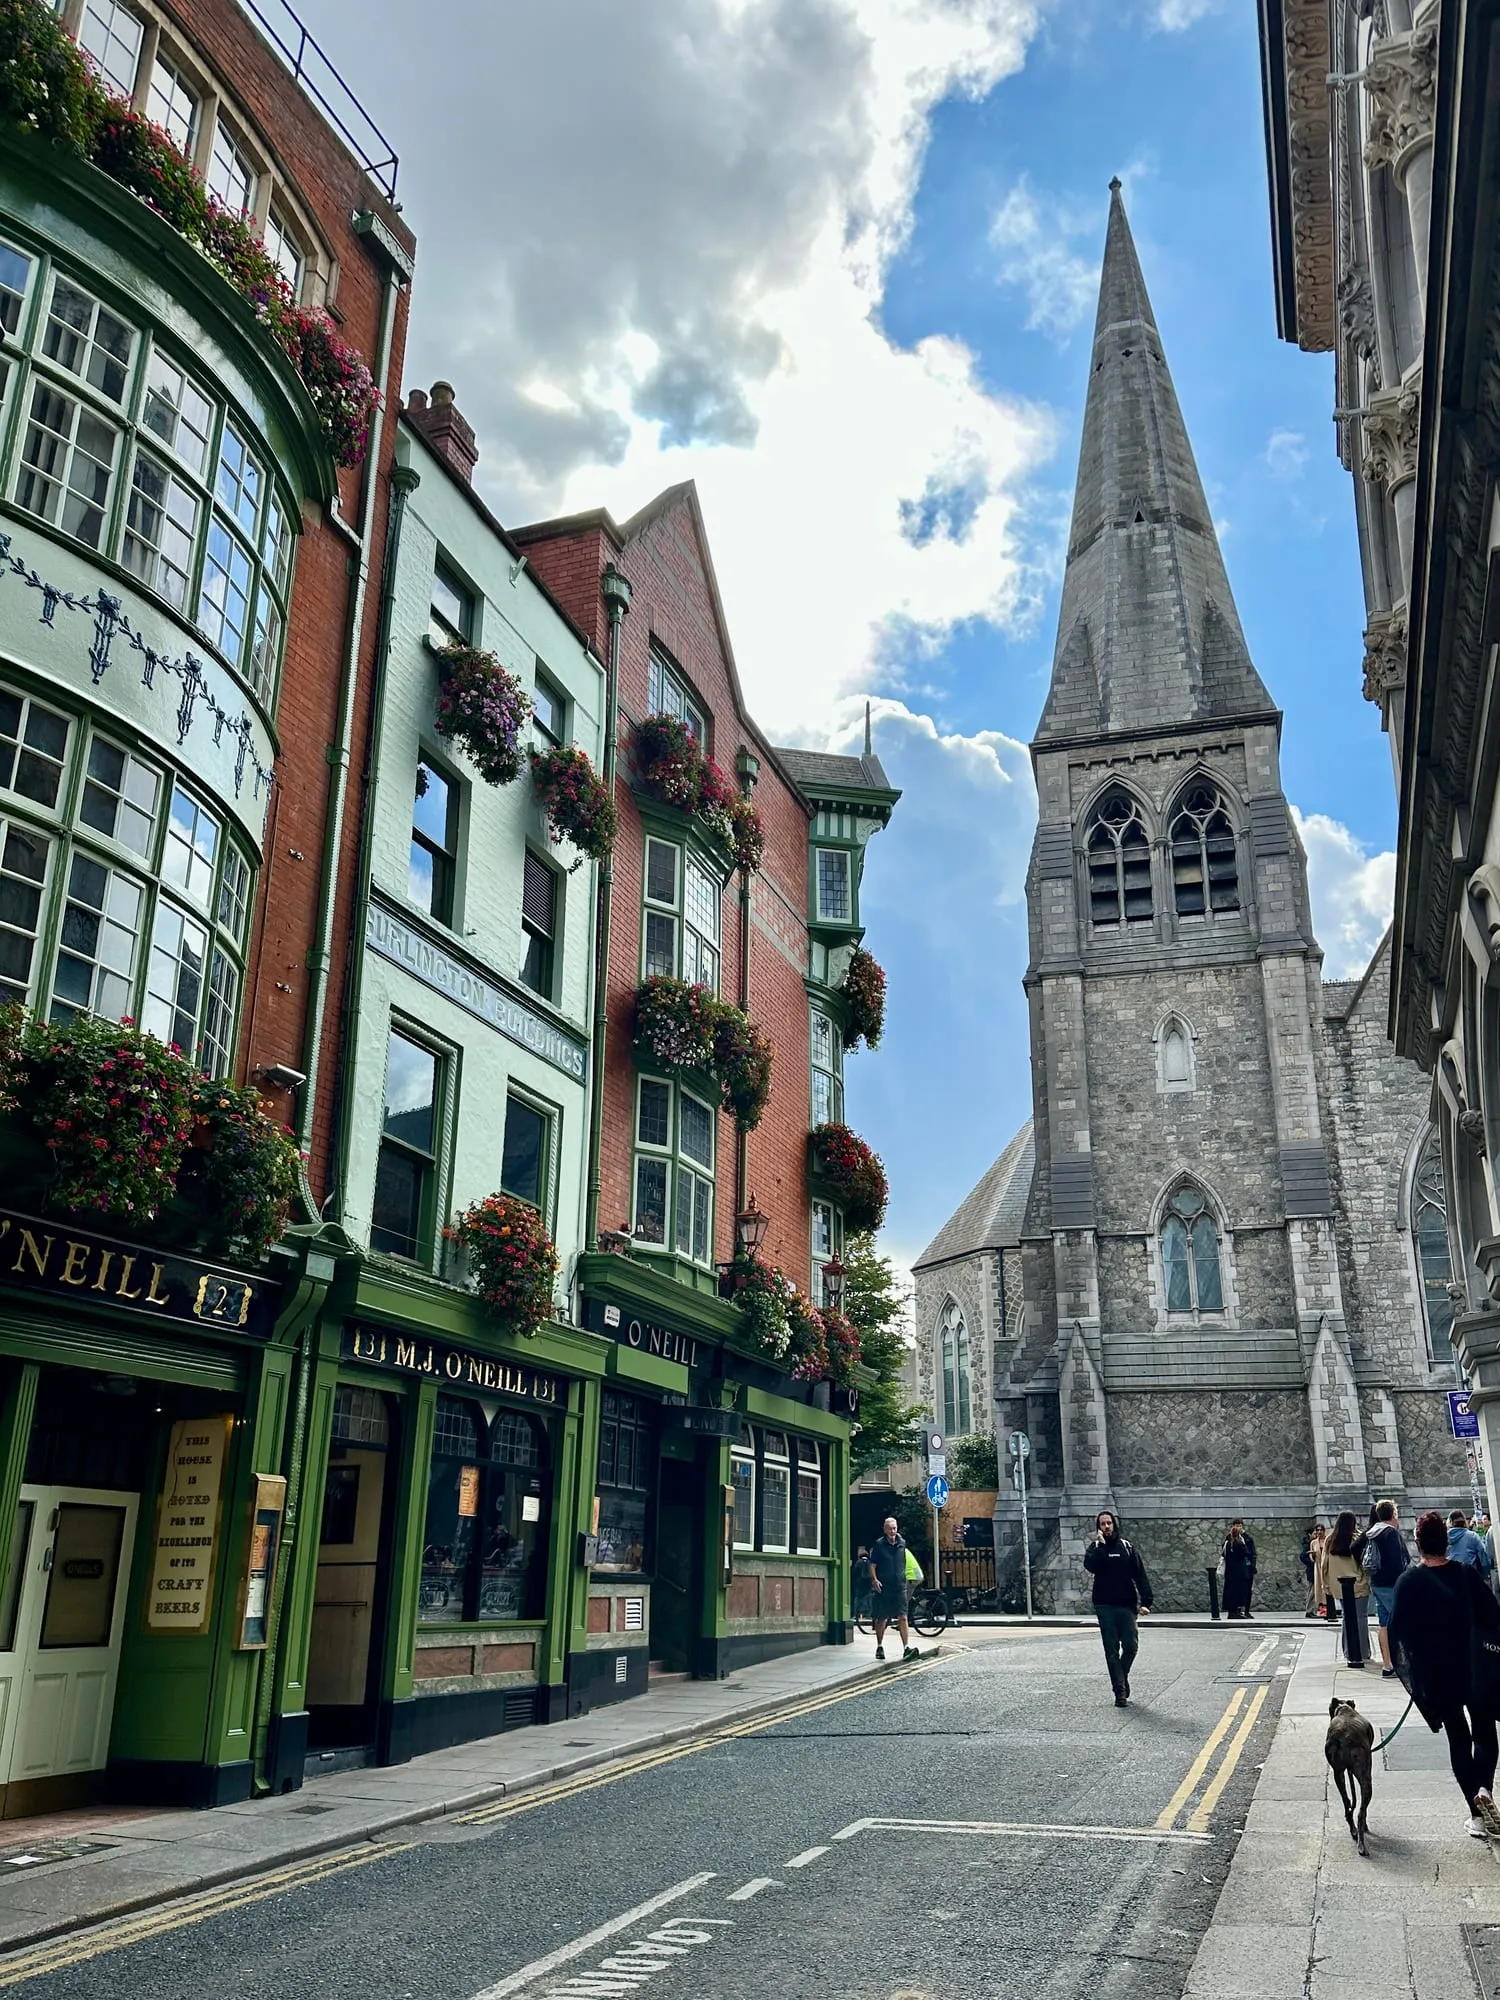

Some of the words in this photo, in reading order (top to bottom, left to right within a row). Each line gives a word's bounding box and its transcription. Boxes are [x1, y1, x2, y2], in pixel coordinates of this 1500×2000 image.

[496, 996, 583, 1077] BUILDINGS
[211, 1285, 228, 1315] 2
[628, 1319, 699, 1368] O'NEILL
[365, 1333, 376, 1356] 3
[393, 1337, 440, 1376] M.J.
[445, 1351, 528, 1396] O'NEILL
[541, 1378, 549, 1399] 3
[185, 1436, 210, 1446] THIS
[178, 1455, 213, 1465] HOUSE
[188, 1475, 197, 1485] IS
[169, 1495, 210, 1507] NOTED
[170, 1516, 186, 1527] FOR
[189, 1516, 206, 1527] THE
[158, 1536, 213, 1547] EXCELLENCE
[170, 1558, 181, 1568] OF
[181, 1558, 197, 1568] ITS
[157, 1578, 205, 1591] CRAFT
[155, 1601, 201, 1614] BEERS
